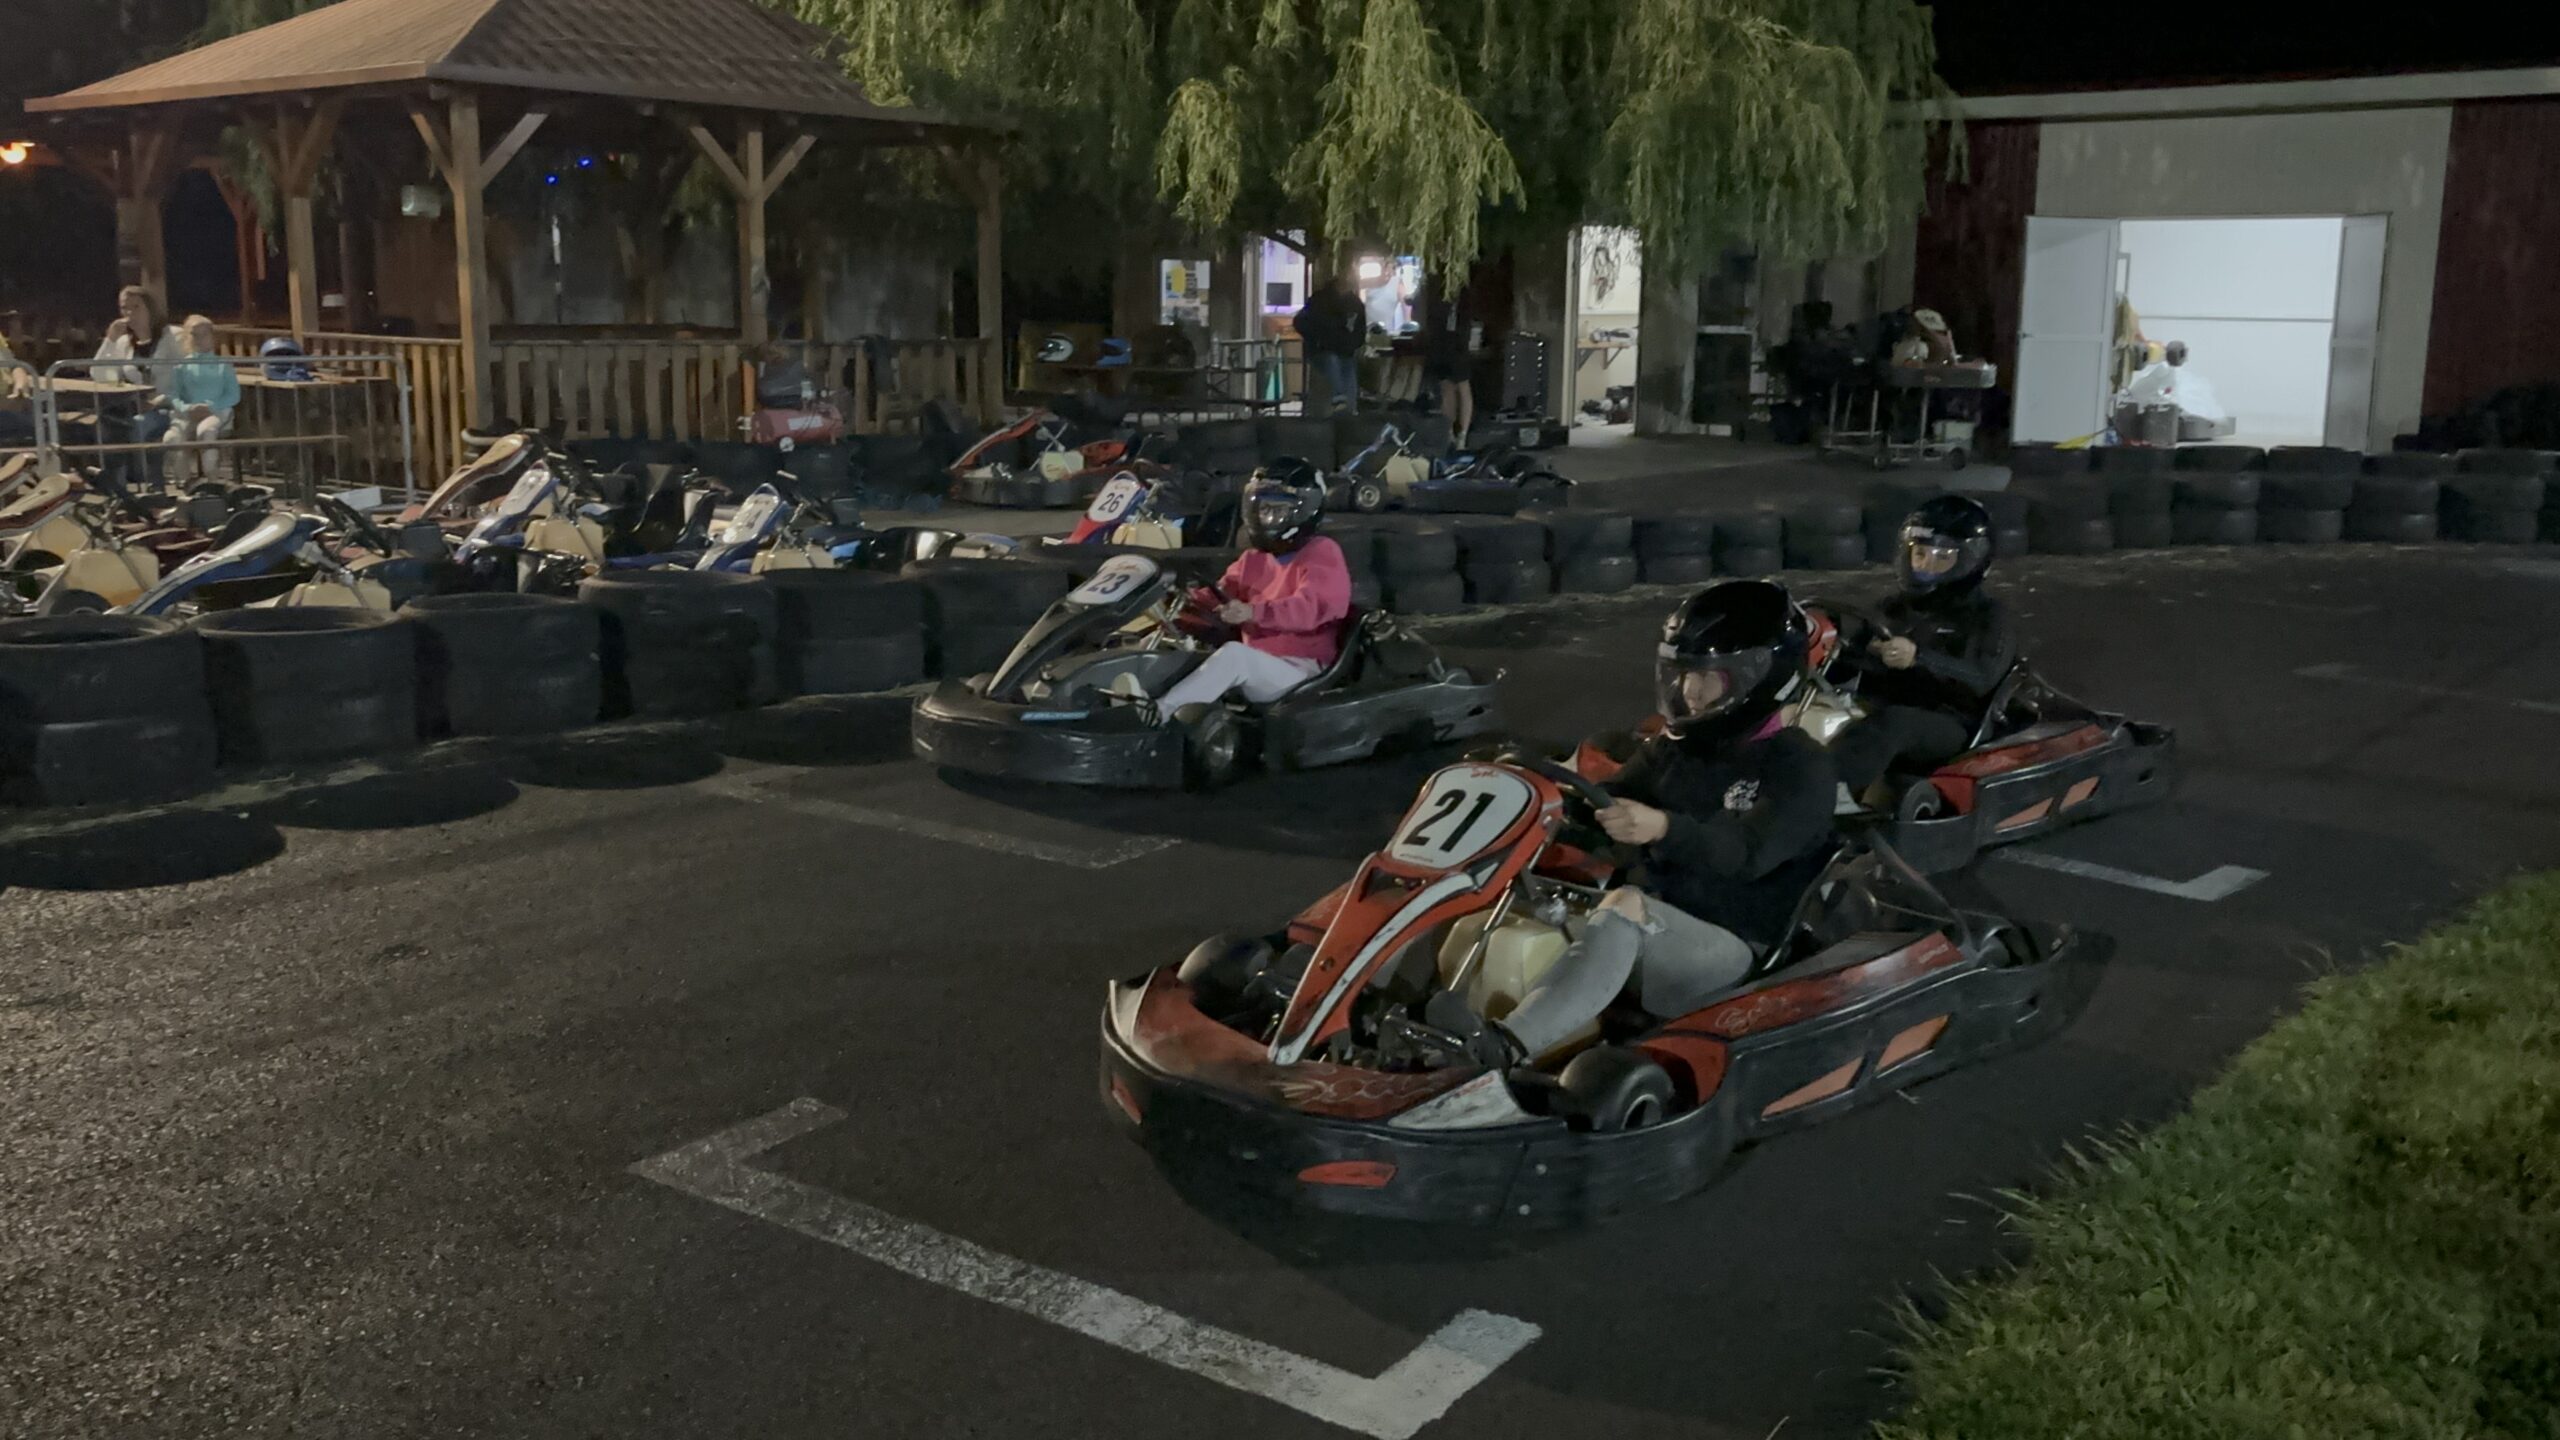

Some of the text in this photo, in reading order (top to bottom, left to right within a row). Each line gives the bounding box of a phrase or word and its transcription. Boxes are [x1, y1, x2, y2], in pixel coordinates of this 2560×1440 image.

[1098, 492, 1124, 513] 26
[1087, 572, 1131, 595] 23
[1402, 789, 1497, 853] 21
